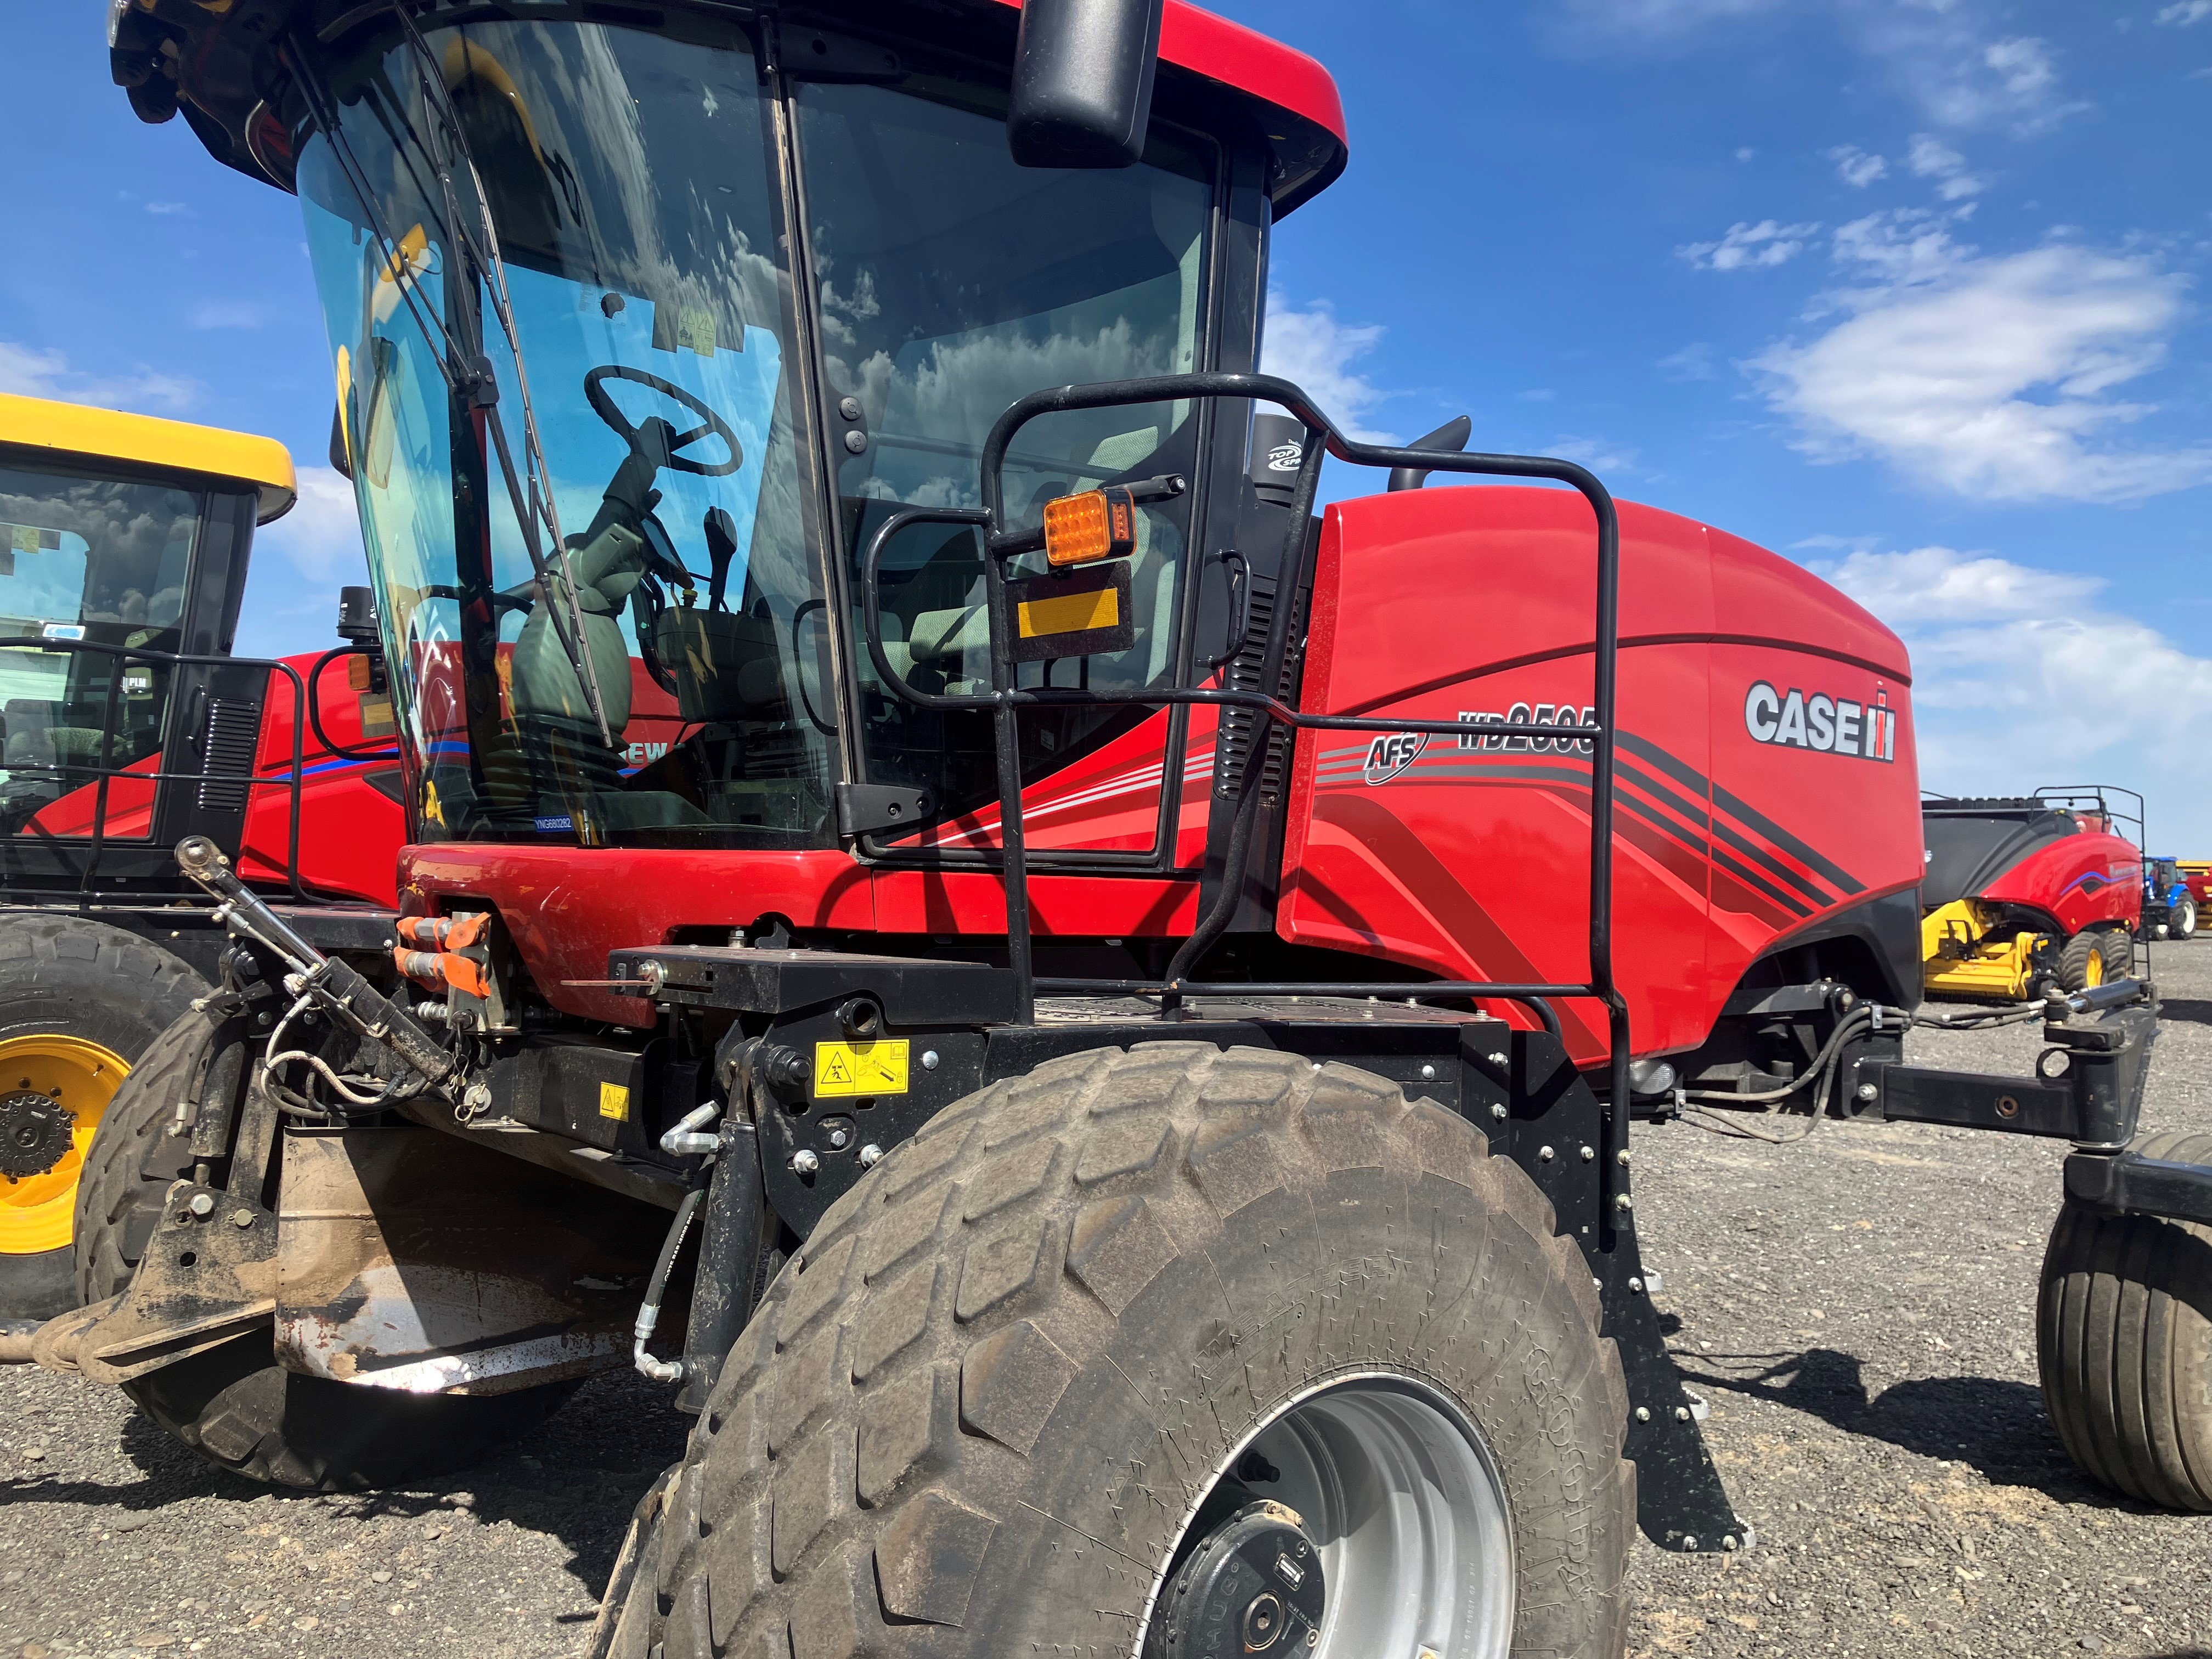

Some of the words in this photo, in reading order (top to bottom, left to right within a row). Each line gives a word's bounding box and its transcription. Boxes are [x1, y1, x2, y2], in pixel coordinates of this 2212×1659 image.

[1268, 450, 1294, 460] TOP
[1458, 702, 1595, 754] WD2505
[1745, 681, 1862, 755] CASE
[1363, 735, 1418, 771] AFS
